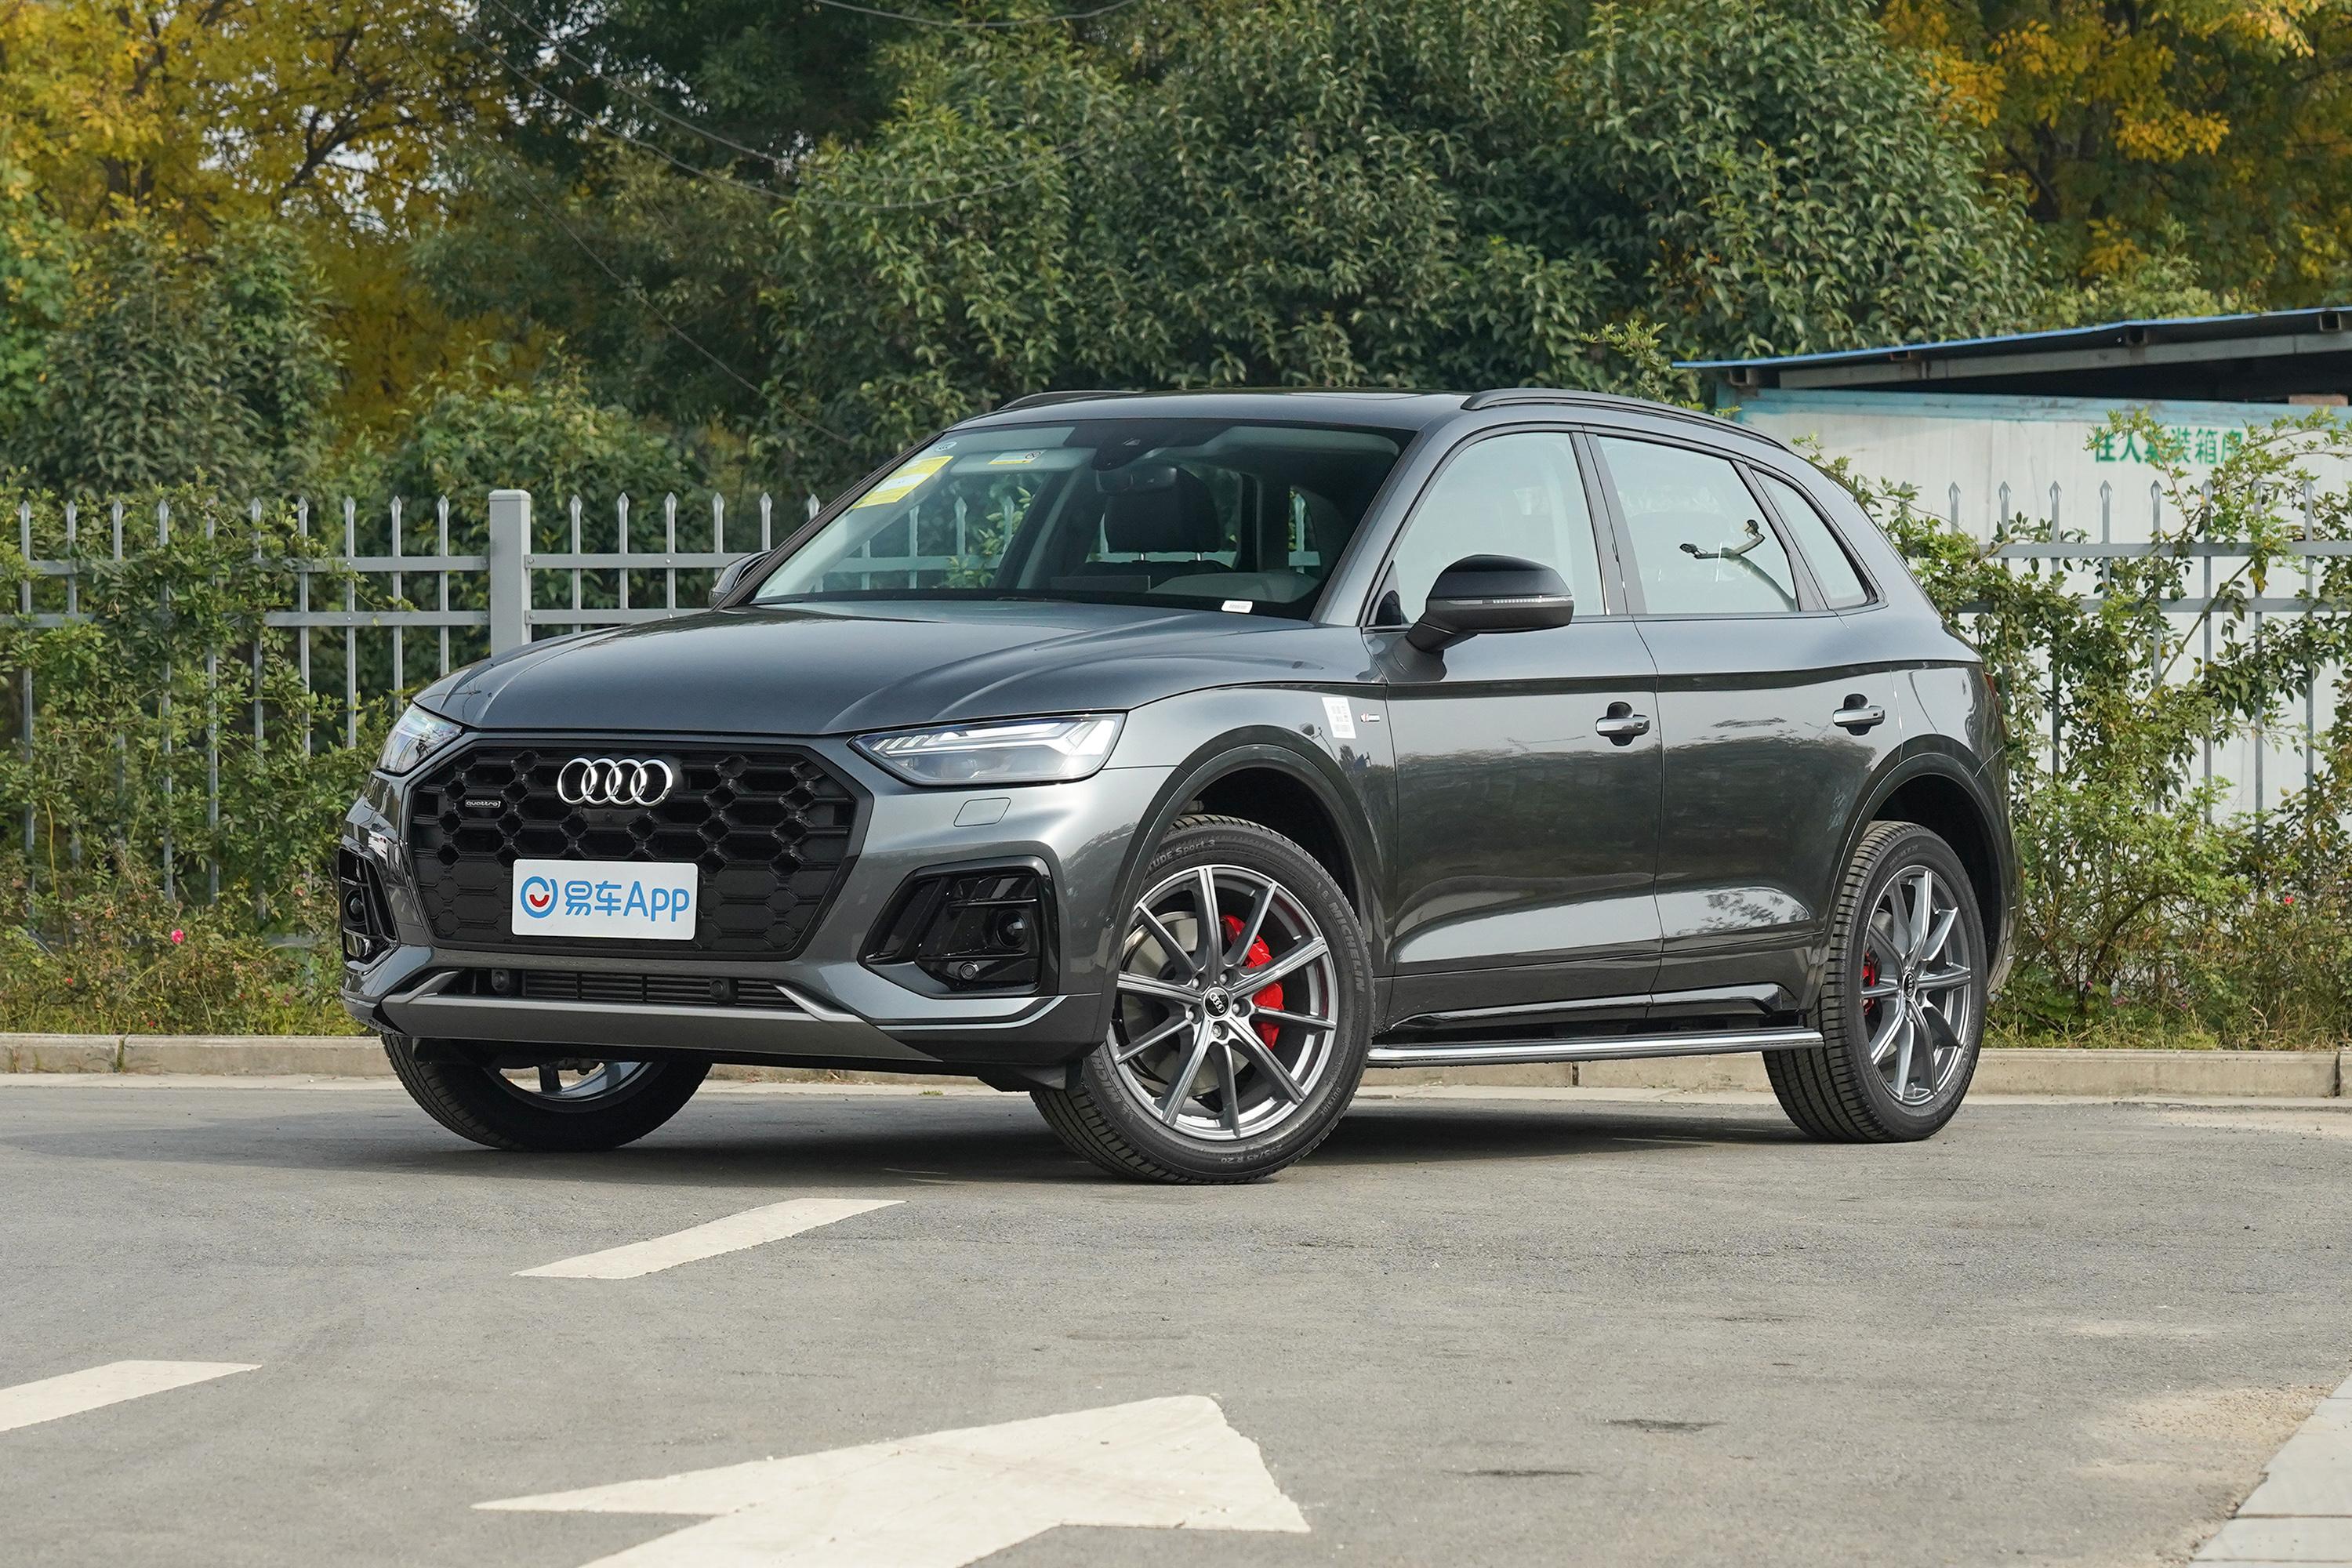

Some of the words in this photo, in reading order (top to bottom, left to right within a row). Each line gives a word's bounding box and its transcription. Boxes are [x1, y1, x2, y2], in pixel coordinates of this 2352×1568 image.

[1176, 840, 1205, 856] Sport
[564, 880, 690, 922] 易车App
[1329, 902, 1365, 993] MICHELIN
